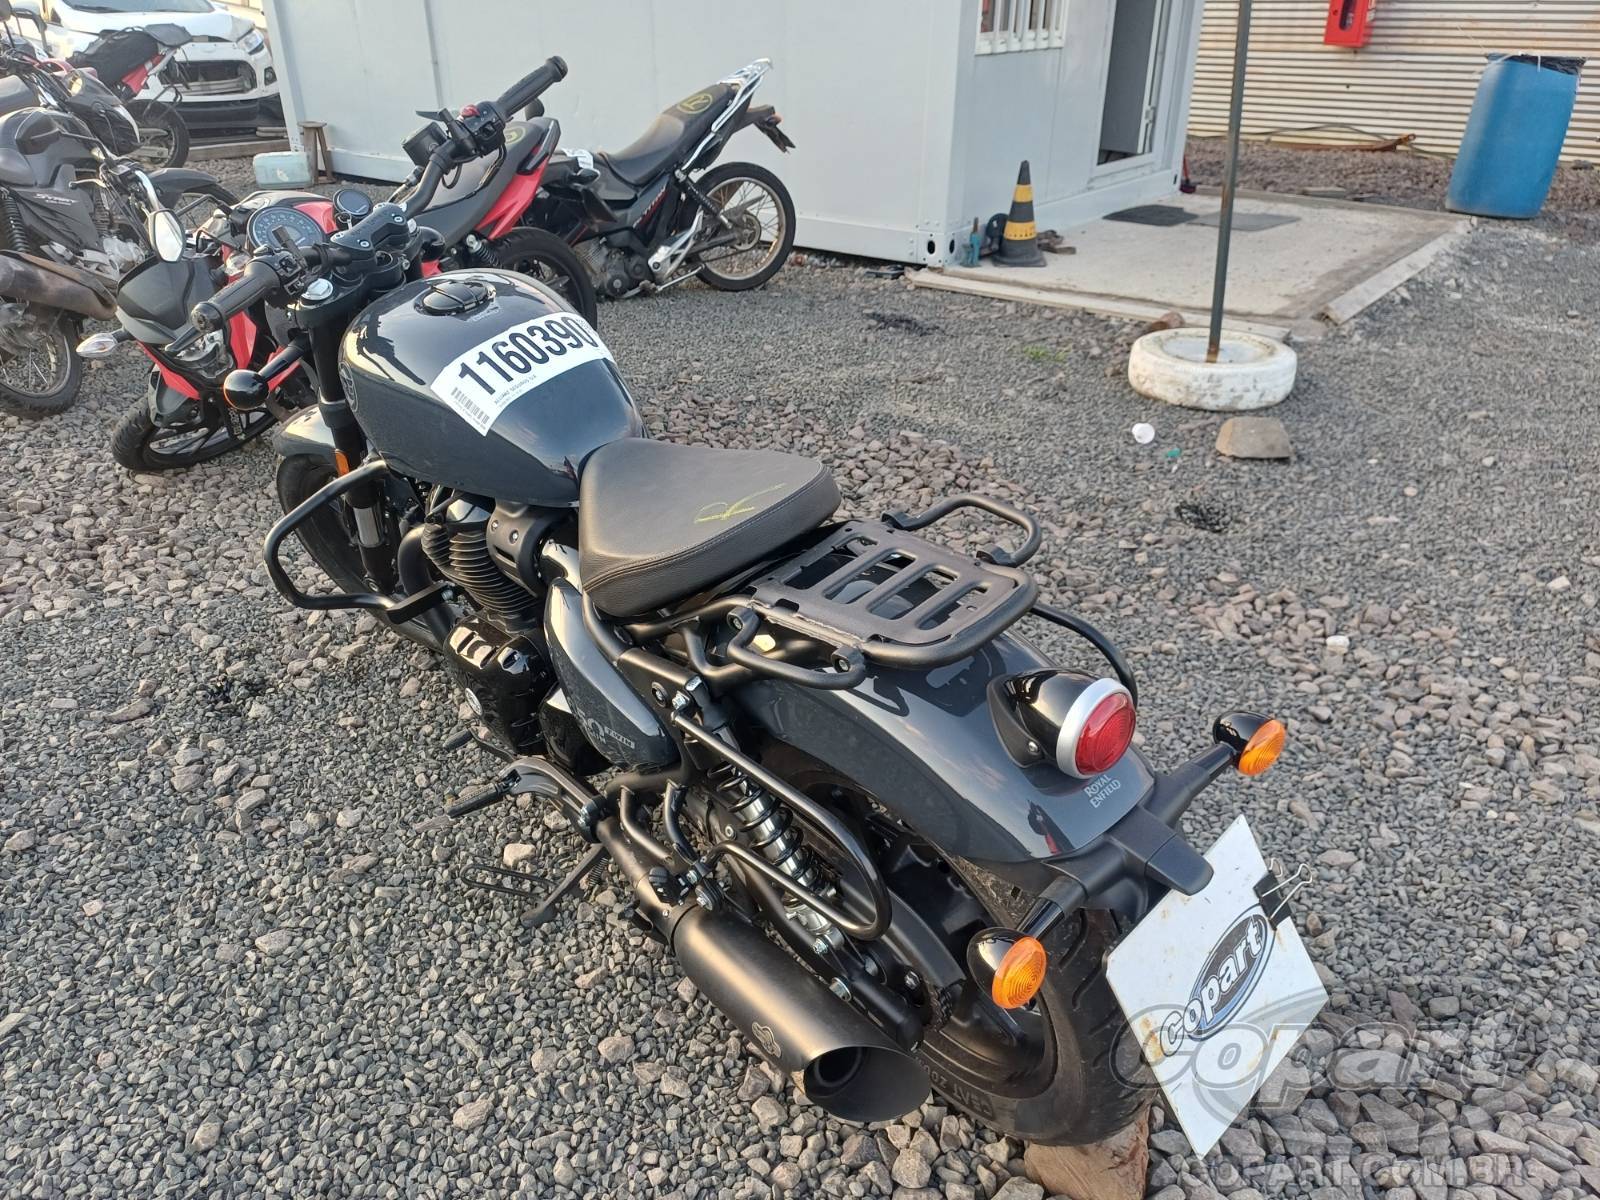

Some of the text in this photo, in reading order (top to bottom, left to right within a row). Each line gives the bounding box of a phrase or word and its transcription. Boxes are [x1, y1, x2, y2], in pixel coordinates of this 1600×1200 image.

[458, 316, 599, 395] 1160390
[1084, 774, 1112, 798] ROYAL
[1090, 779, 1121, 808] ENFIELD
[1159, 914, 1264, 1057] Copart
